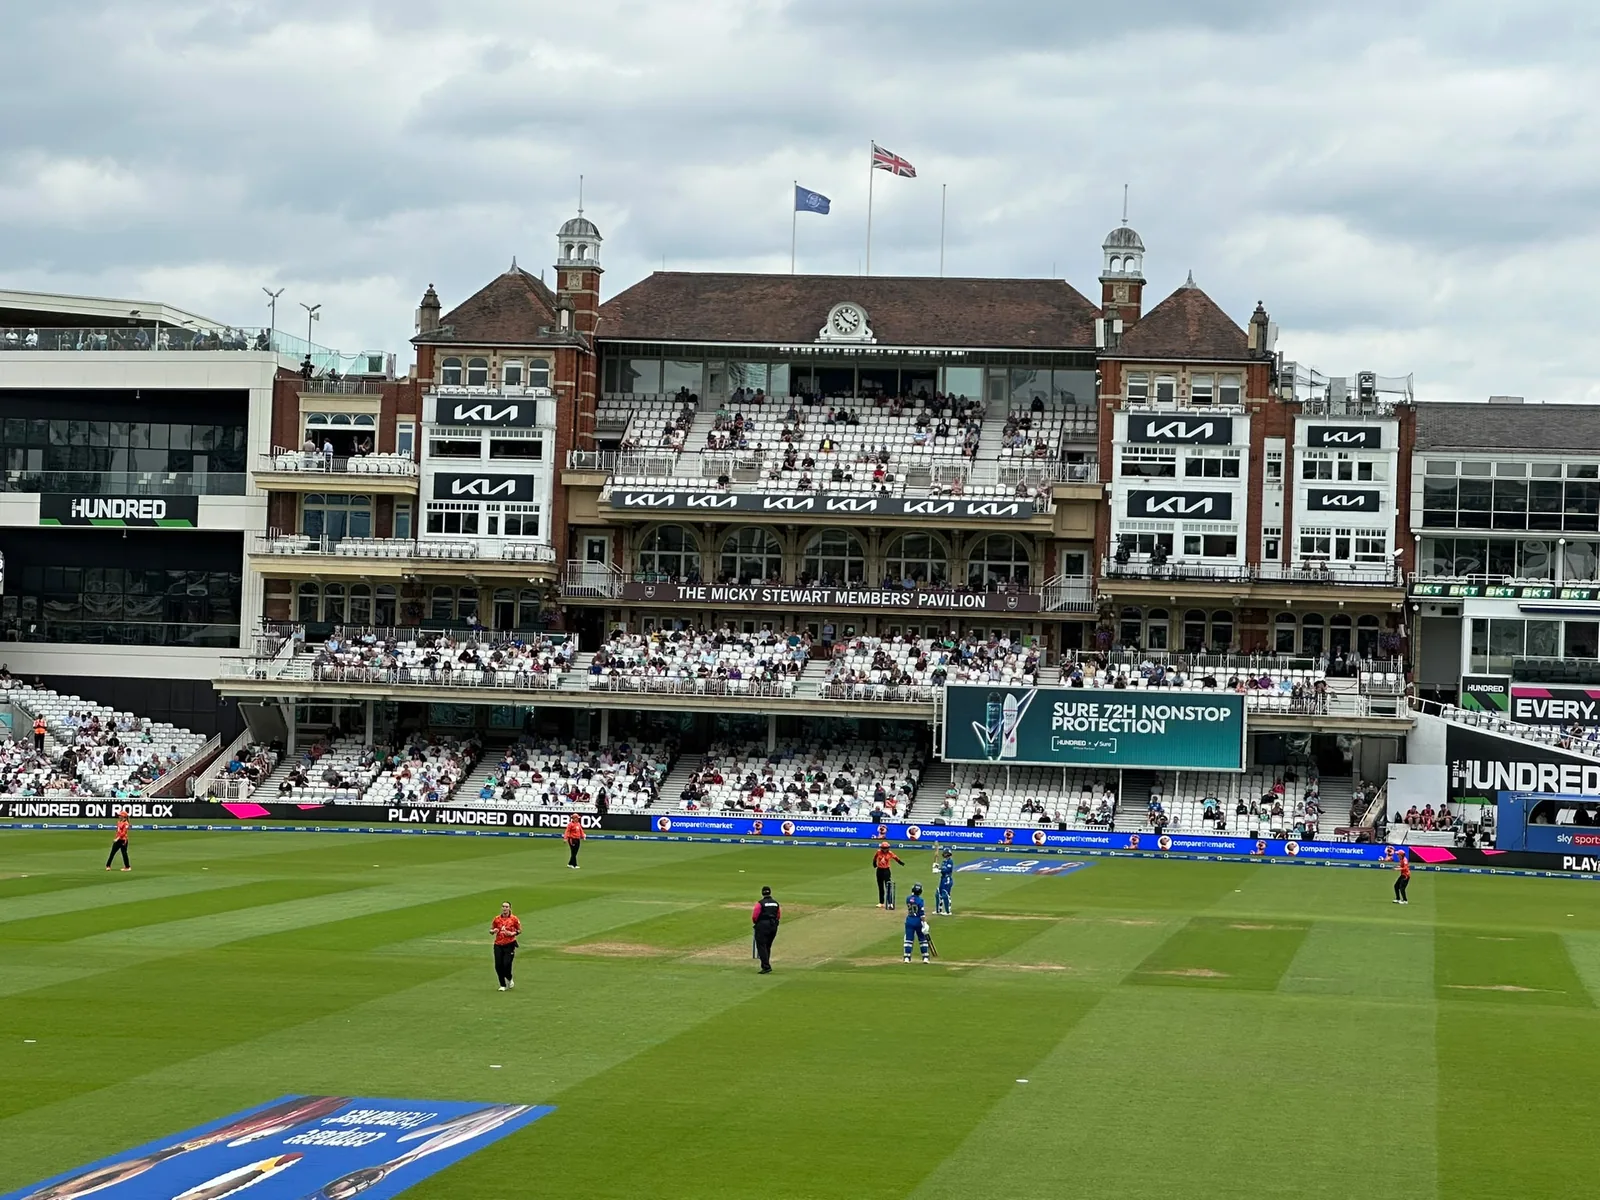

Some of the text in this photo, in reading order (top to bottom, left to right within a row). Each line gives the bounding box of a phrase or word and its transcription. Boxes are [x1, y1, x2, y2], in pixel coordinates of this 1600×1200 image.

[72, 498, 167, 518] HUNDRED
[1413, 584, 1442, 595] BKT
[1450, 585, 1478, 596] BKT
[1485, 586, 1515, 597] BKT
[1522, 587, 1551, 598] BKT
[1561, 588, 1590, 600] BKT
[677, 586, 986, 608] THE MICKY STEWART MEMBERS' PAVILION
[1467, 684, 1504, 692] HUNDRED
[1053, 701, 1231, 722] SURE 72H NONSTOP
[1516, 698, 1597, 720] EVERY.
[1052, 716, 1166, 734] PROTECTION
[1057, 739, 1087, 747] HUNDRED
[1452, 760, 1600, 795] HUNDRED
[8, 803, 80, 817] HUNDRED
[86, 804, 107, 818] ON
[111, 804, 173, 818] ROBLOX
[388, 809, 602, 829] PLAY HUNDRED ON ROBOX
[672, 821, 734, 831] comparethemarket
[796, 825, 857, 834] comparethemarket
[922, 829, 984, 840] comparethemarket
[1048, 835, 1110, 845] comparethemarket
[1557, 833, 1573, 845] sky
[1173, 840, 1236, 850] comparethemarket
[1301, 845, 1364, 855] comparethemarket
[1563, 855, 1598, 871] PLAY
